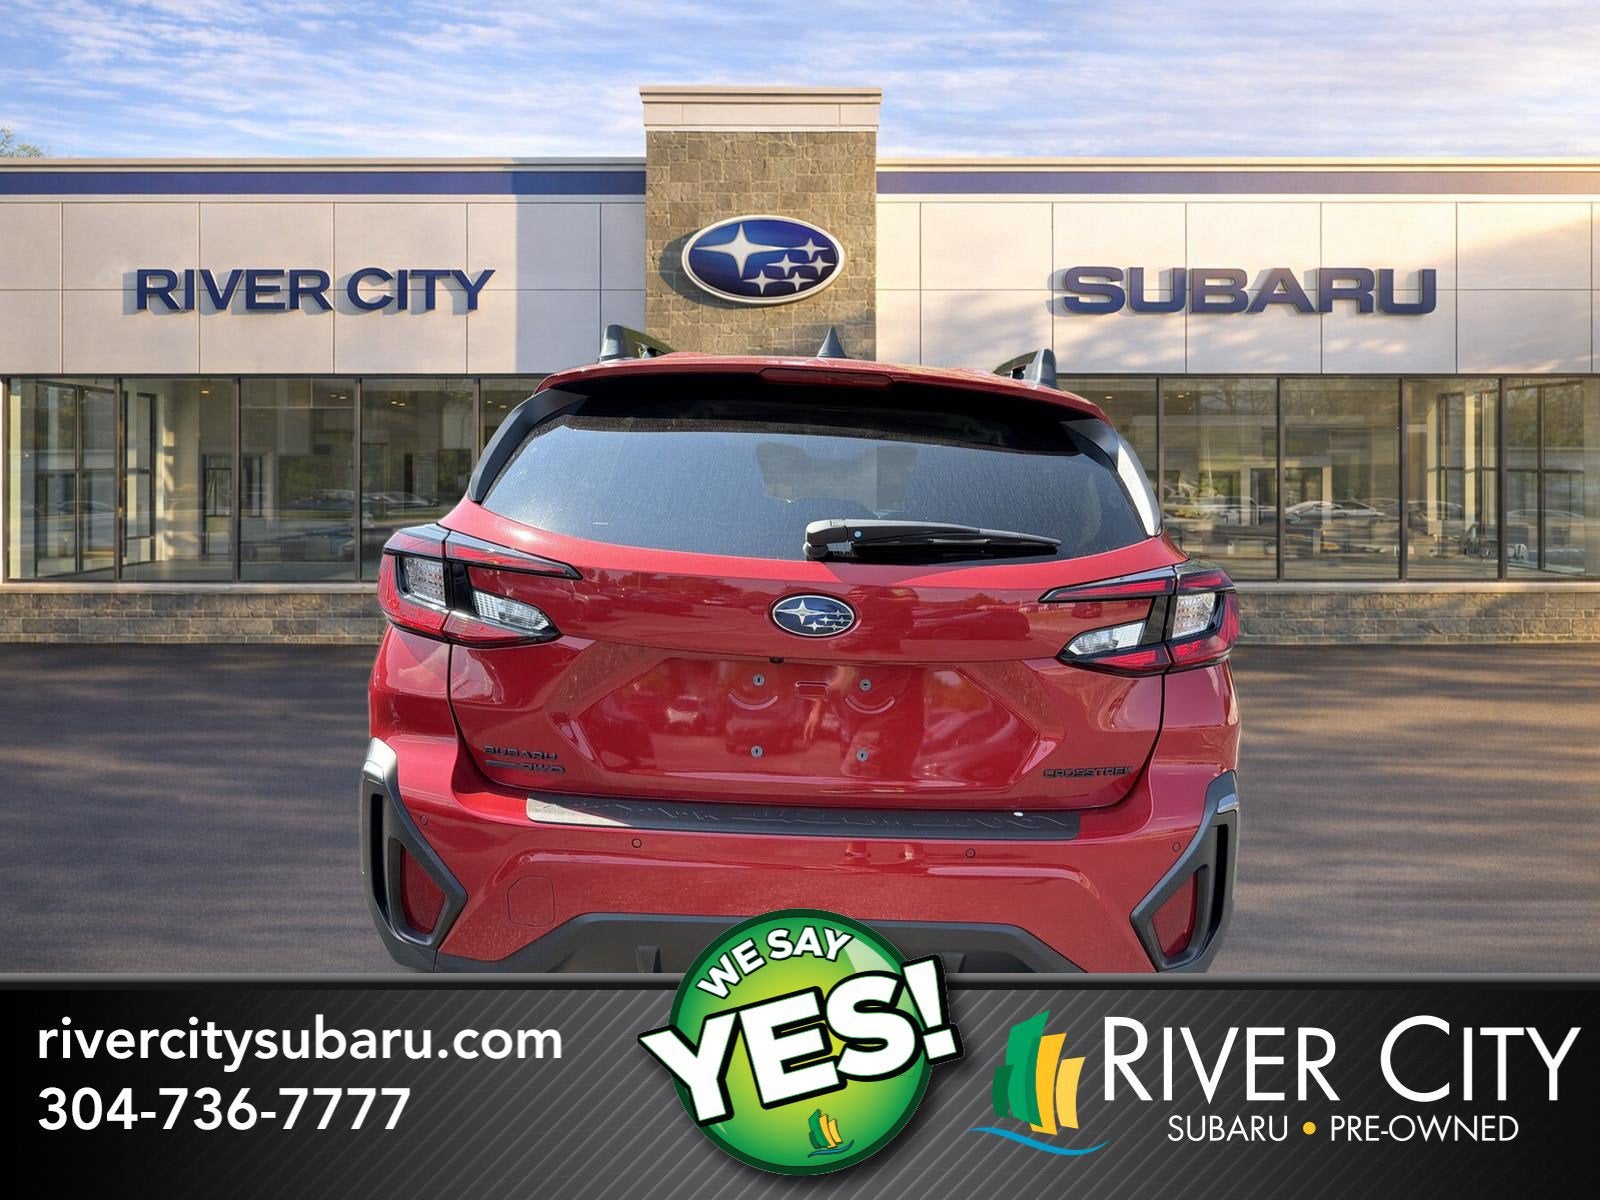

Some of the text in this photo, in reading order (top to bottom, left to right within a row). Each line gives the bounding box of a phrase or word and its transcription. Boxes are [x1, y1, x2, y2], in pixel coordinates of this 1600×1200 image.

[136, 266, 496, 312] RIVER CITY
[1063, 266, 1437, 315] SUBARU
[483, 745, 558, 760] SUBARU
[1043, 766, 1133, 778] CROSSTREK
